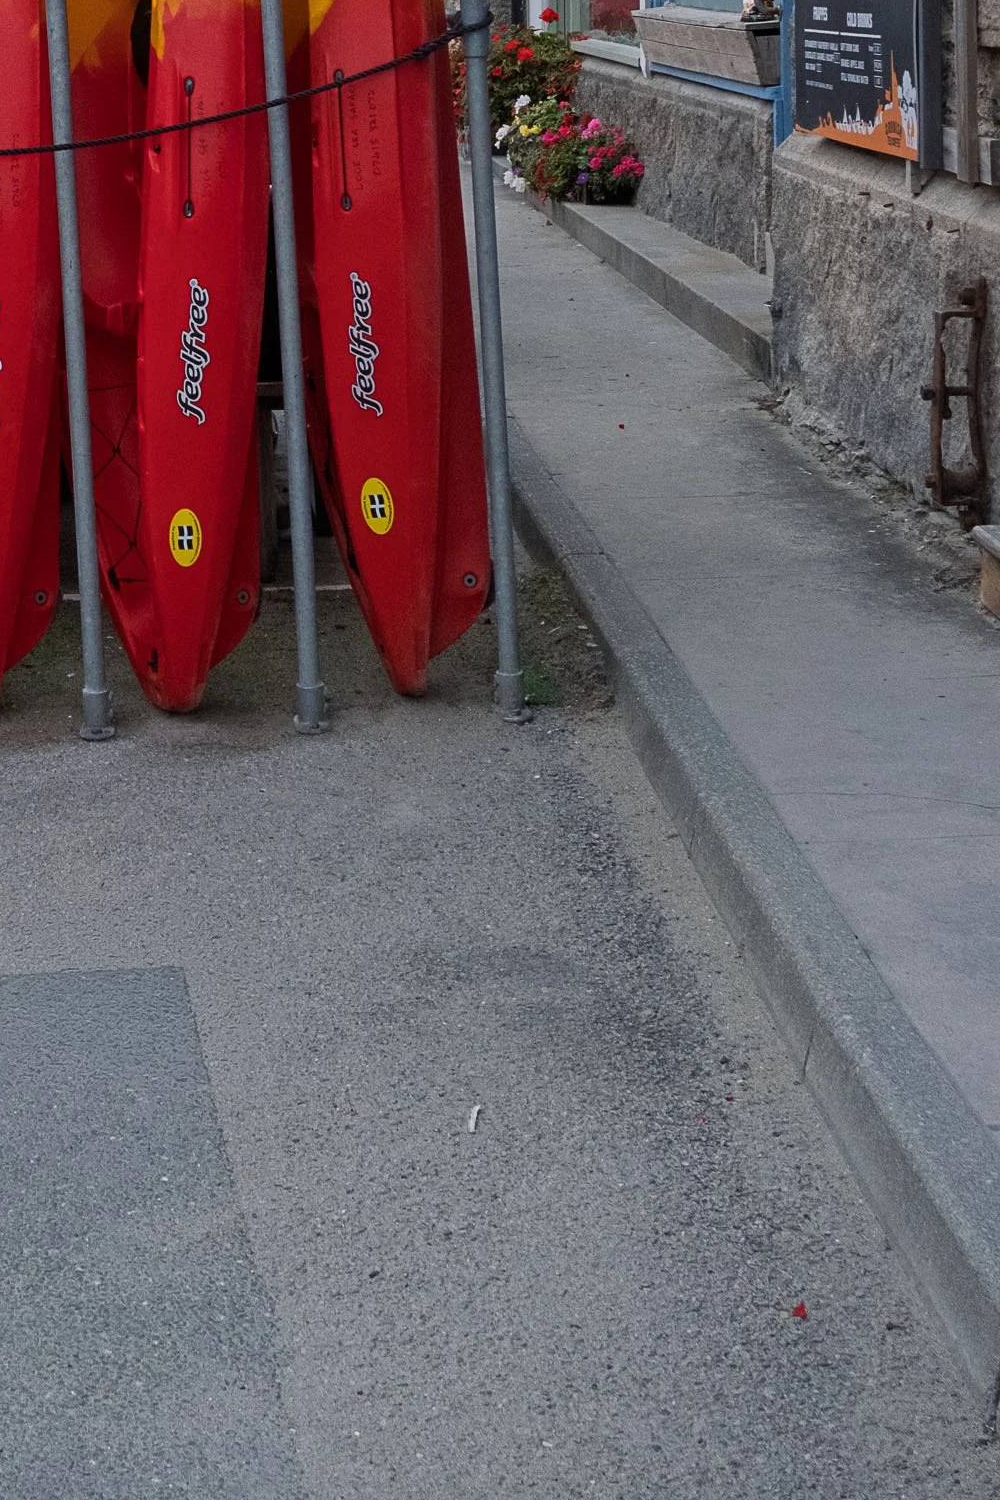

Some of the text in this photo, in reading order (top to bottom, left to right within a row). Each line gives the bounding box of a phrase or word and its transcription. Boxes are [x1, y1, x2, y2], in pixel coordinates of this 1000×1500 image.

[847, 12, 872, 28] COLD DRINKS
[177, 286, 210, 425] feelfree
[349, 280, 384, 417] feelfree
